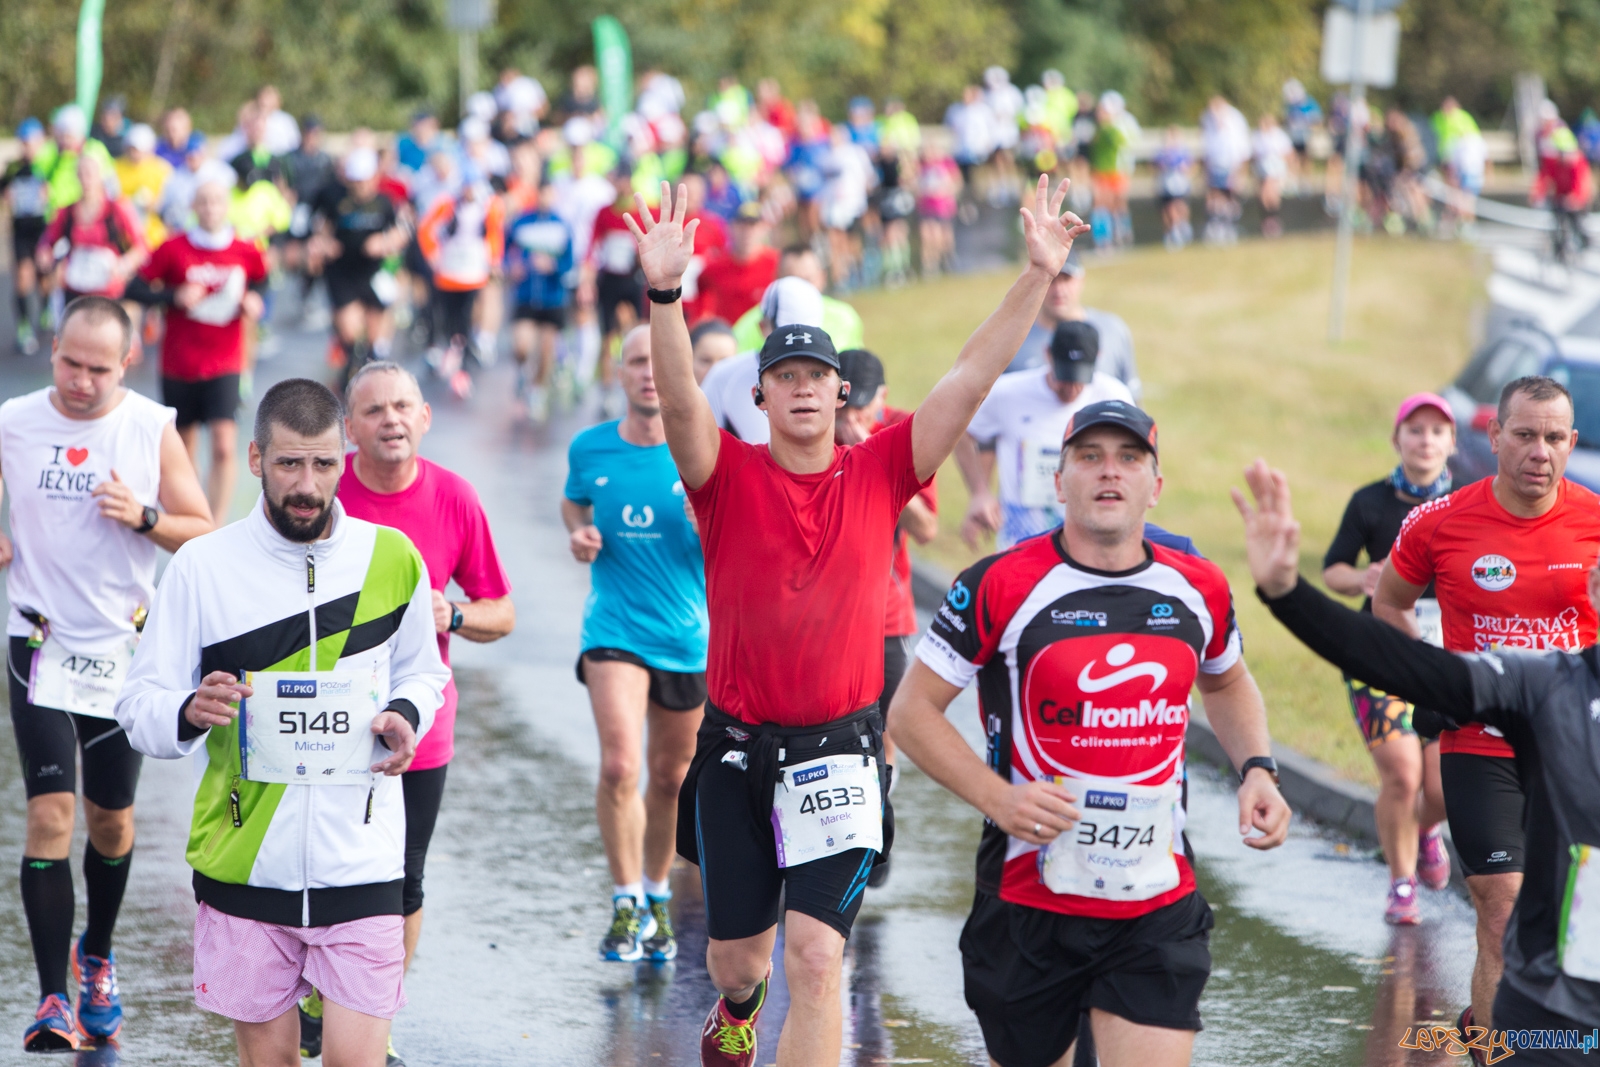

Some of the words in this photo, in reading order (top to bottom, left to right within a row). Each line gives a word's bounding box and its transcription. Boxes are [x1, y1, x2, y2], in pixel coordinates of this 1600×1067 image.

[49, 445, 64, 466] I
[37, 467, 96, 493] JEŻYCE
[1482, 556, 1506, 565] MTS
[1051, 609, 1107, 620] GoPro
[1472, 613, 1563, 633] DRUŻYNA
[61, 655, 116, 679] 4752
[278, 711, 350, 734] 5148
[294, 741, 335, 751] Michał
[1070, 734, 1163, 748] Celironman.pl
[799, 786, 867, 815] 4633
[820, 812, 853, 827] Marek
[1077, 821, 1155, 850] 3474
